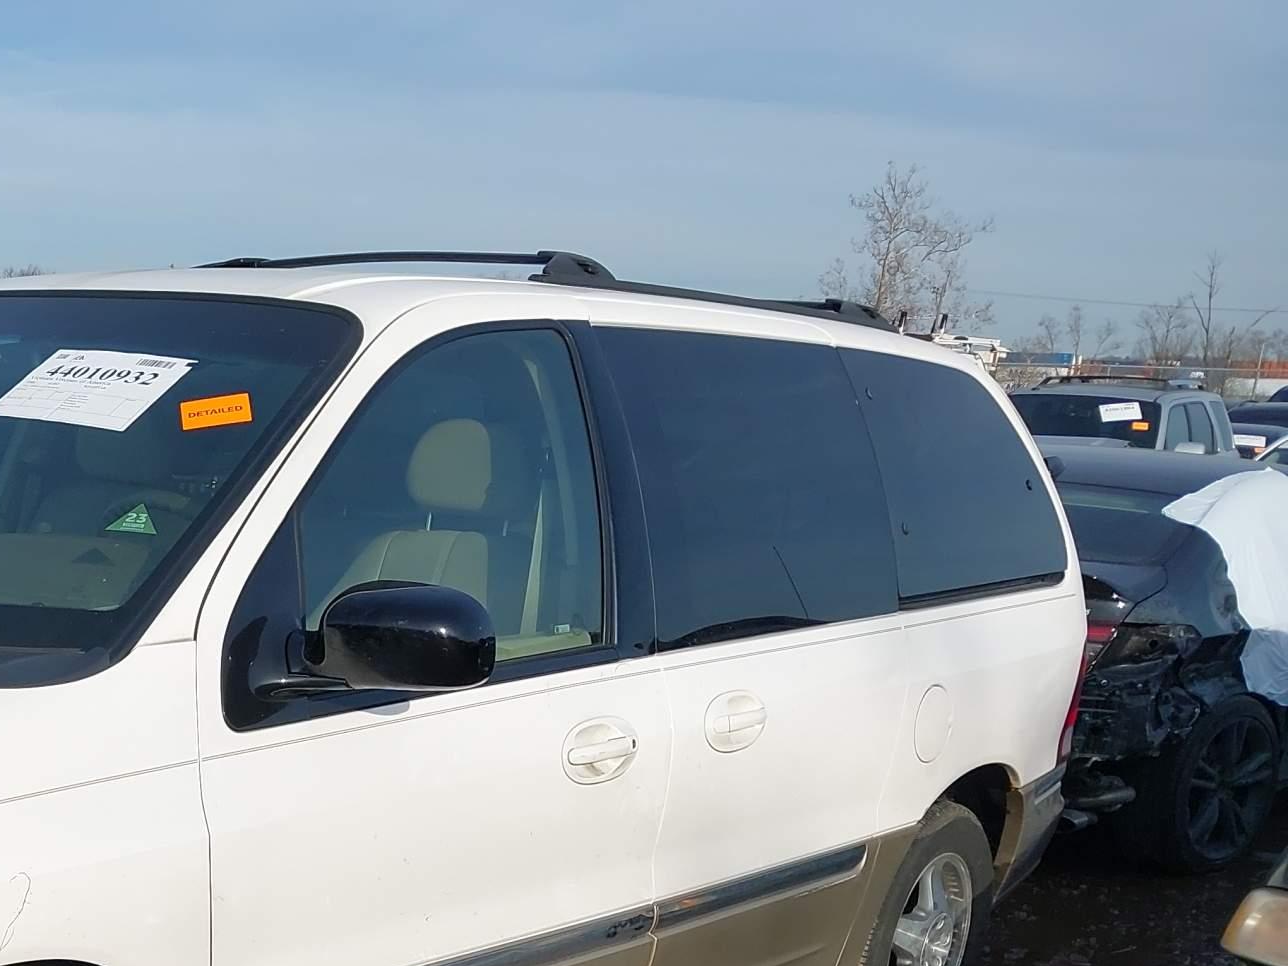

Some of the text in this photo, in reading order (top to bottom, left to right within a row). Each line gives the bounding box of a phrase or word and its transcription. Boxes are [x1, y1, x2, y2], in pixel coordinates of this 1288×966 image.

[46, 363, 160, 386] 44010932
[187, 405, 243, 418] DETAILED
[125, 512, 148, 523] 23
